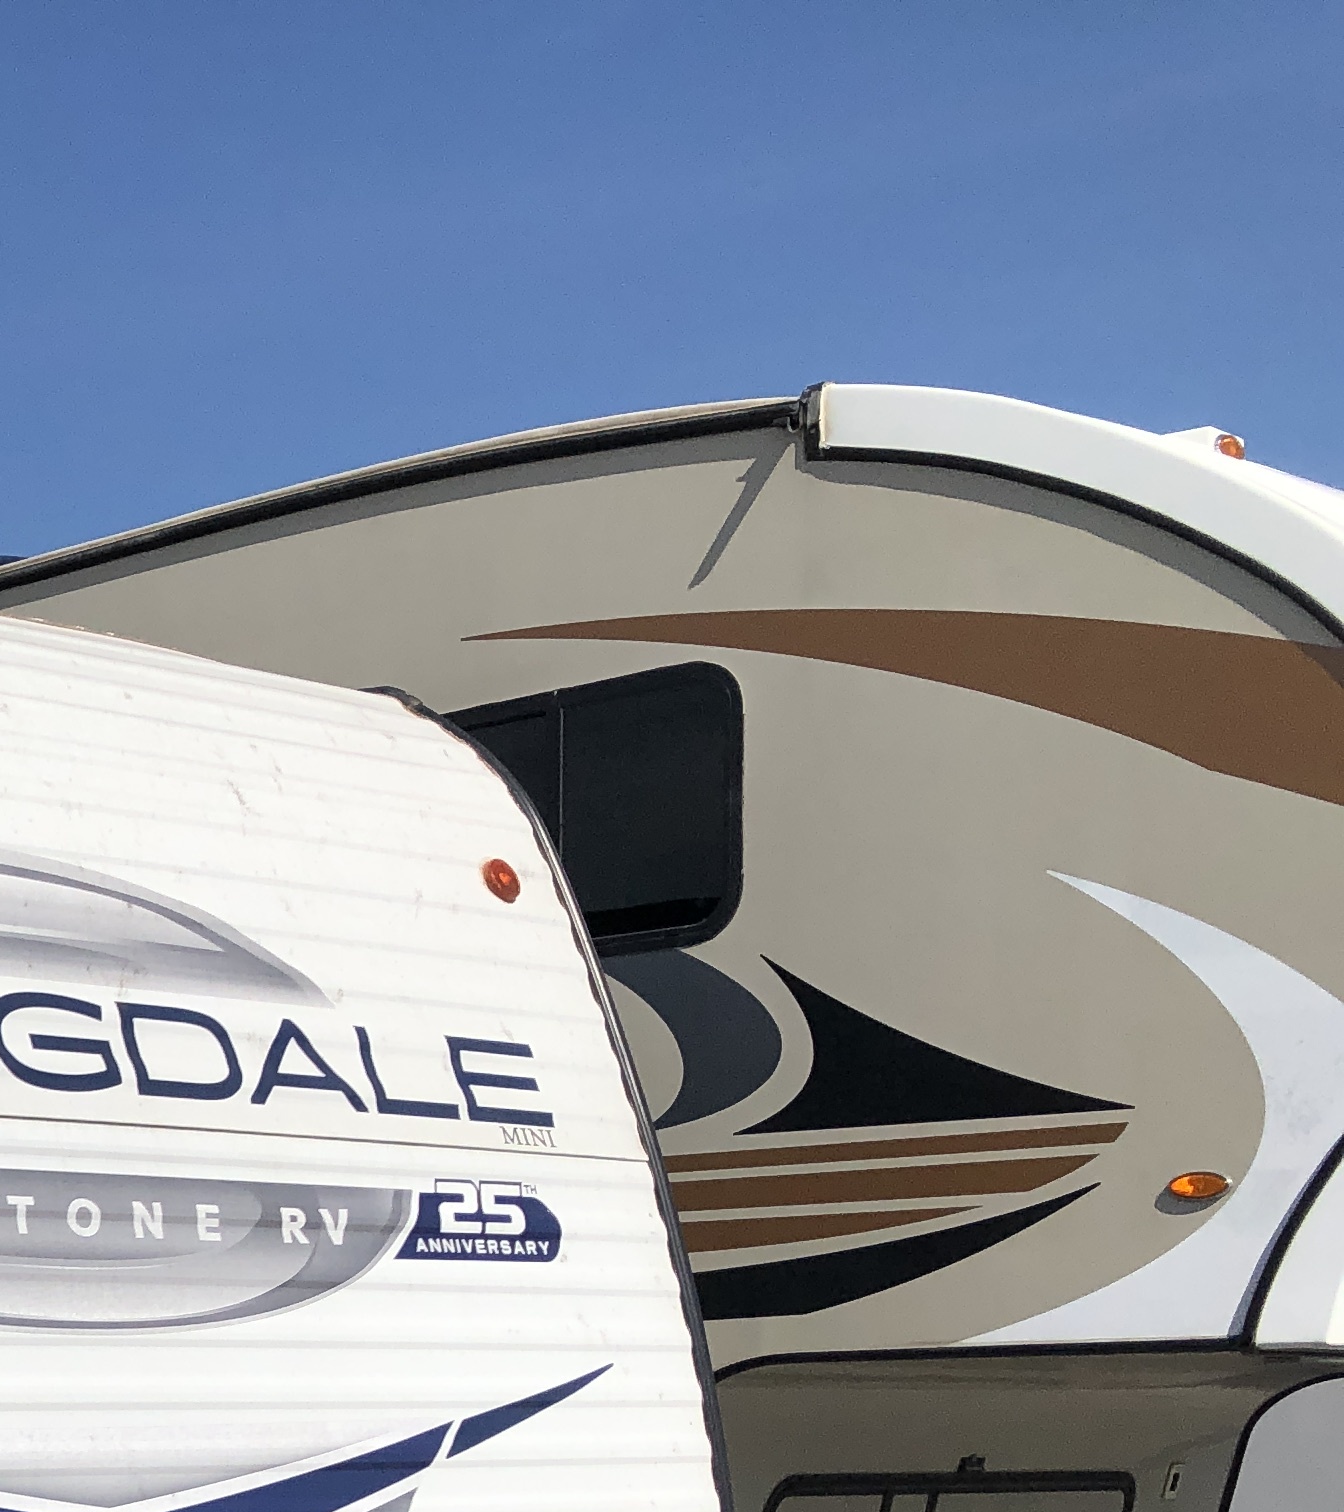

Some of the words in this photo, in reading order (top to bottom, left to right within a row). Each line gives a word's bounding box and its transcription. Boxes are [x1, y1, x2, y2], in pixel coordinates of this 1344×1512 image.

[499, 1125, 557, 1148] MINI
[279, 1204, 349, 1246] RV
[415, 1237, 550, 1256] ANNIVERSARY
